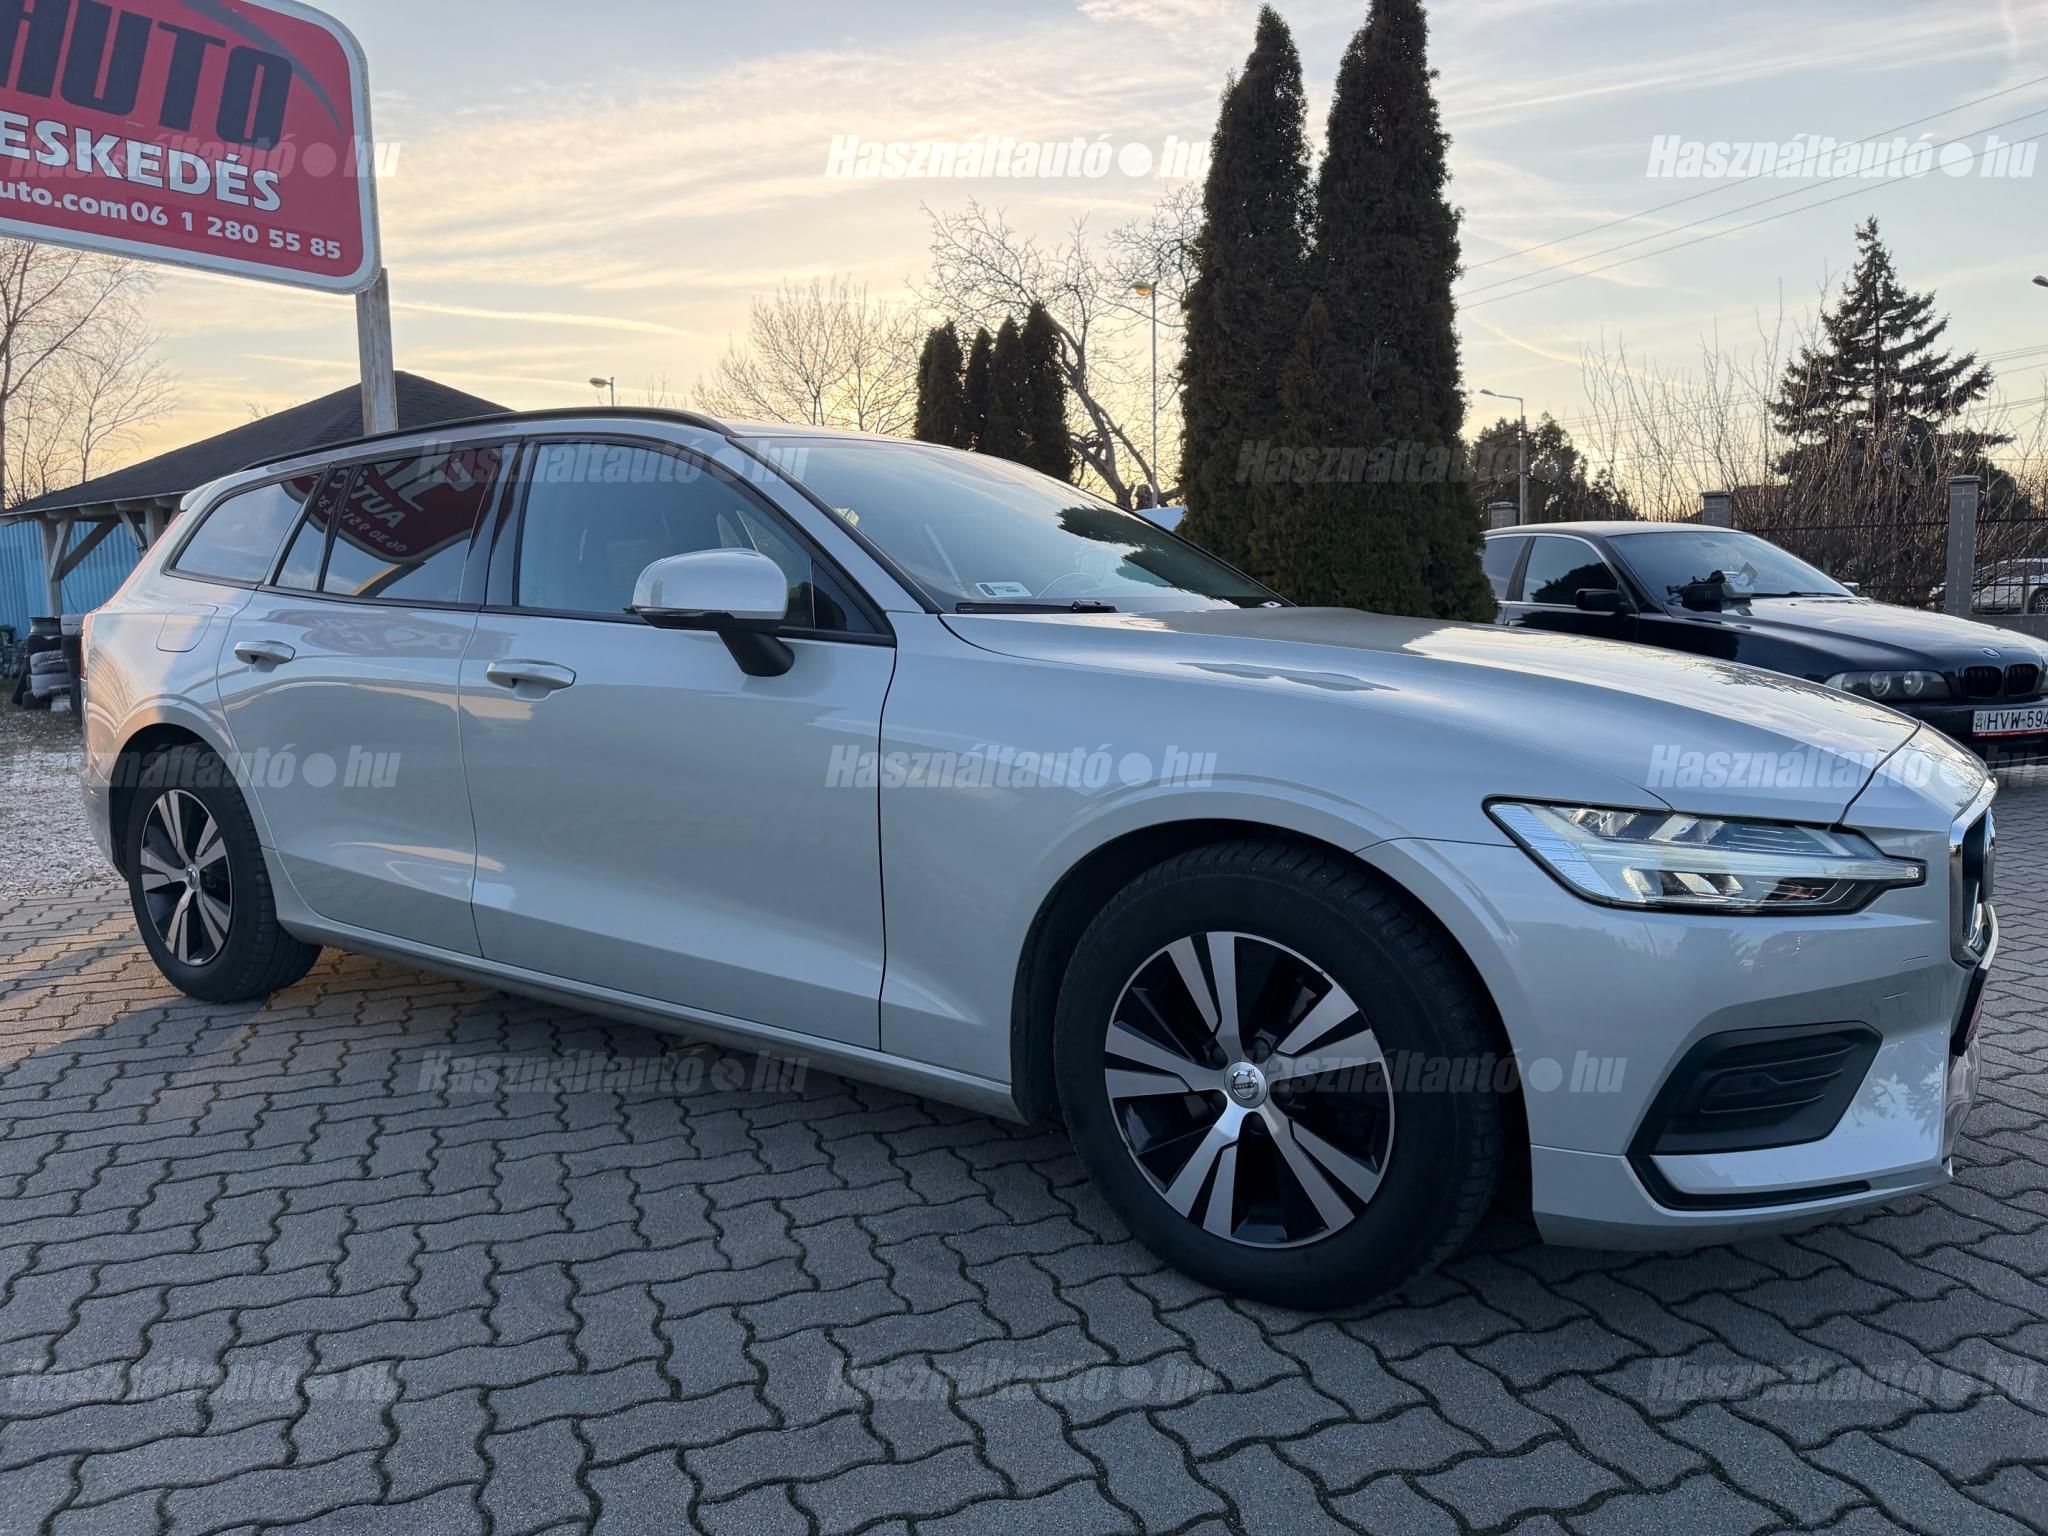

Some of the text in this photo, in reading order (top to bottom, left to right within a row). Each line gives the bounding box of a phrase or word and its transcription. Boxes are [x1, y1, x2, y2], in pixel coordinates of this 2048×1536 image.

[0, 111, 281, 212] ESKEDÉS
[130, 201, 168, 226] 06
[182, 212, 193, 231] 1
[207, 216, 259, 243] 280
[269, 229, 301, 251] 55
[310, 237, 341, 259] 85
